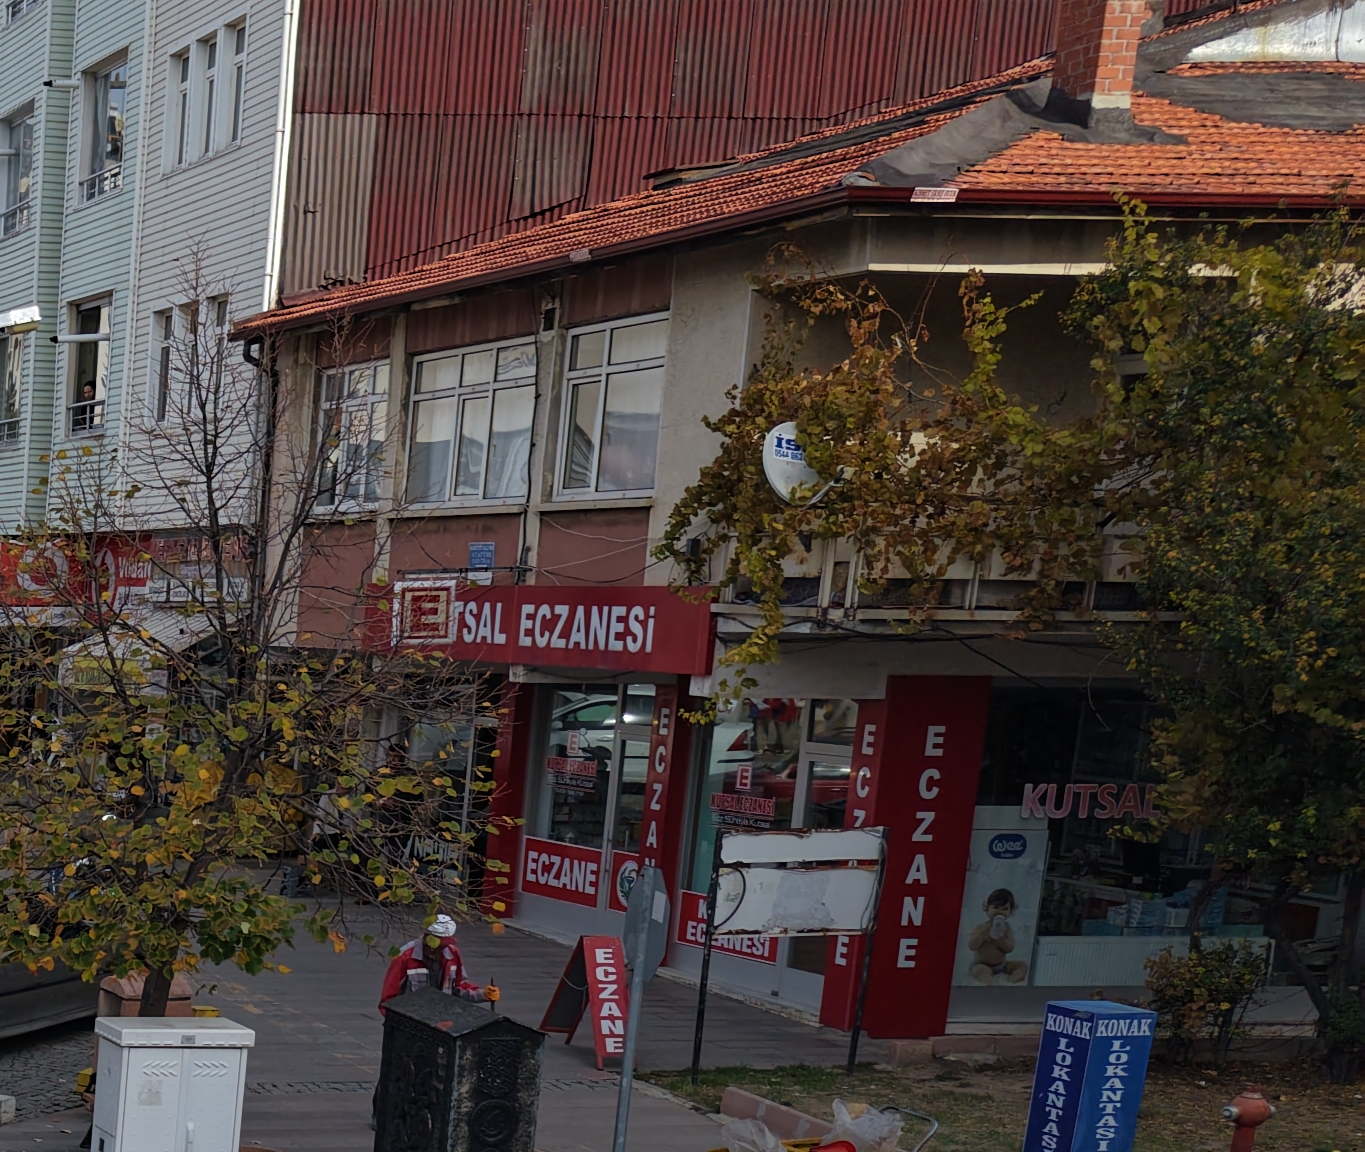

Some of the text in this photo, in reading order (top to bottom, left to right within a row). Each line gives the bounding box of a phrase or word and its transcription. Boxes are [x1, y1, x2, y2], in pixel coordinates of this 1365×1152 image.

[518, 604, 655, 653] ECZANESİ
[1021, 783, 1162, 819] KUTSAL
[897, 725, 947, 968] ECZANE
[525, 850, 598, 895] ECZANE
[594, 948, 625, 1053] ECZANE
[1046, 1013, 1092, 1040] KONAK
[1095, 1019, 1153, 1037] KONAK
[1095, 1040, 1131, 1152] LOKANTASI
